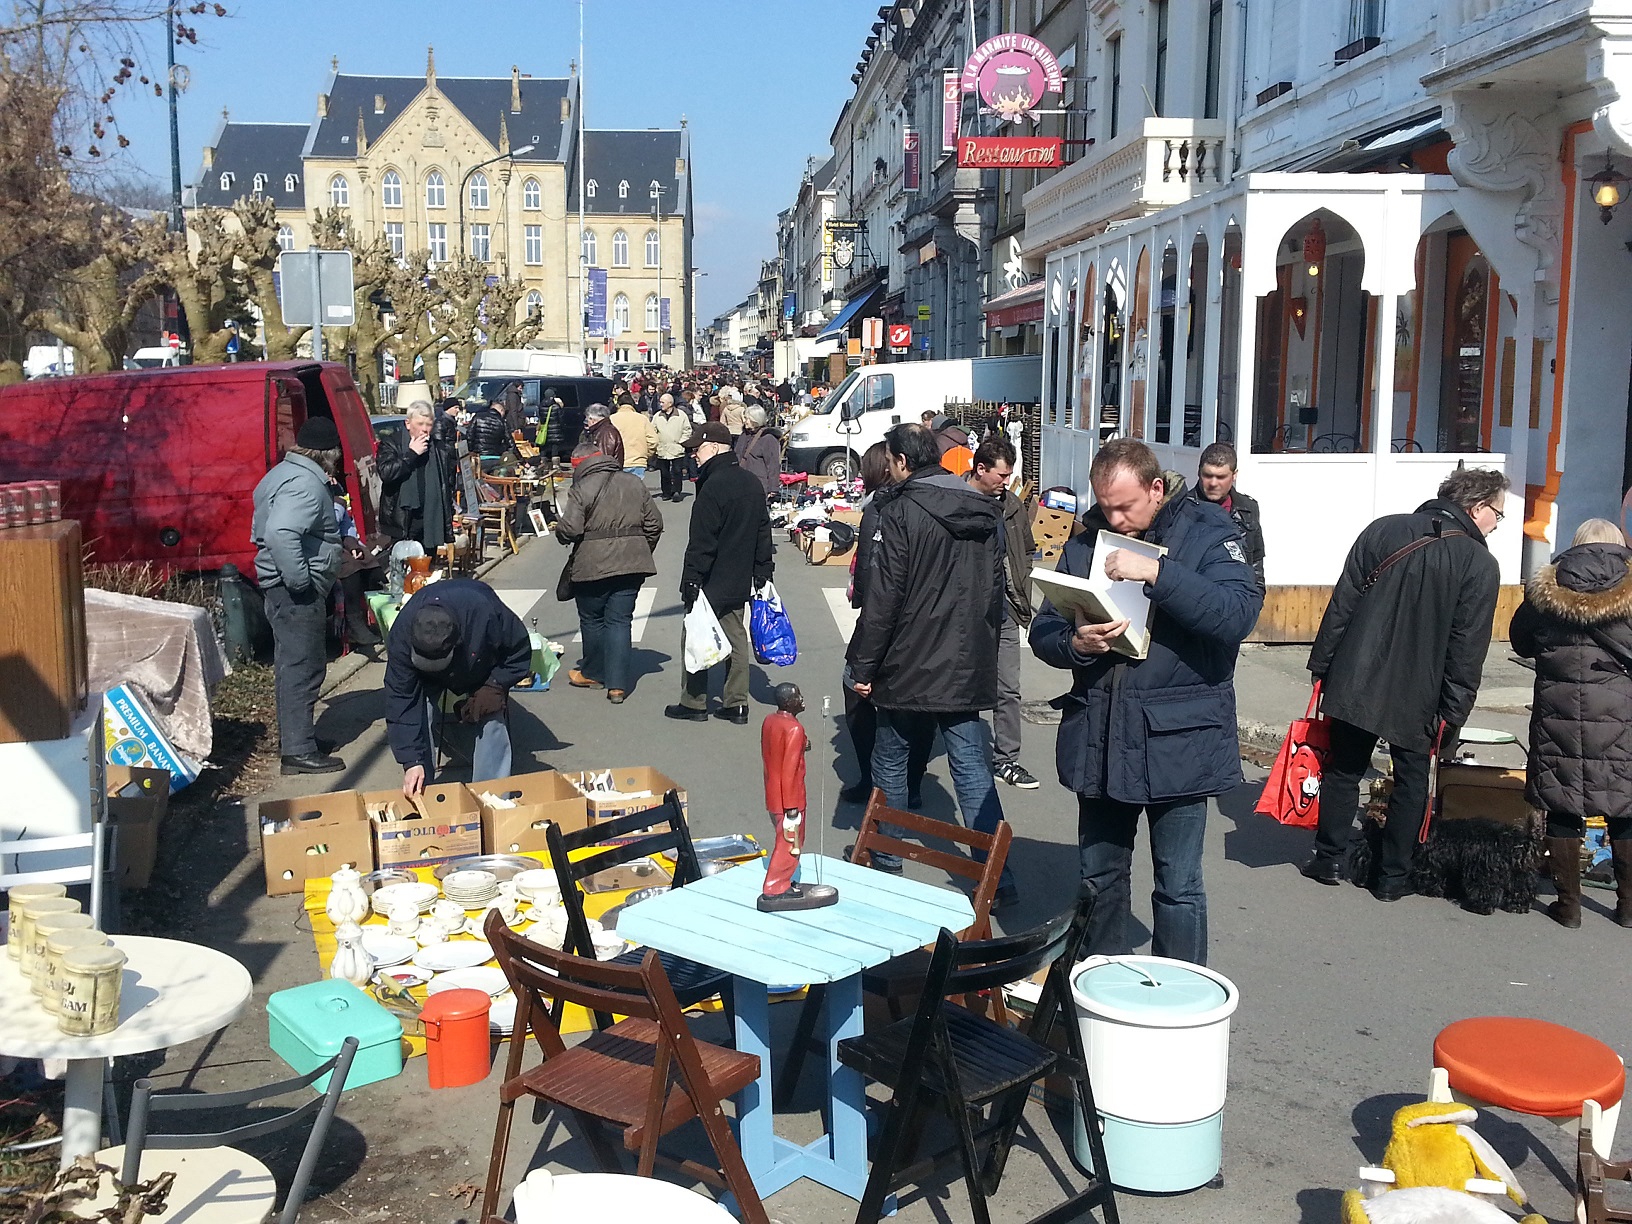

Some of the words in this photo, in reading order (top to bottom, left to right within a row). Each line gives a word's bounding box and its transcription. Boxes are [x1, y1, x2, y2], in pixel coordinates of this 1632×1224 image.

[975, 35, 1017, 63] MARMITE
[965, 63, 978, 78] LA
[1021, 38, 1061, 92] UKRAINIENNE
[963, 82, 974, 90] A
[962, 140, 1056, 166] Restaurant
[116, 698, 149, 739] PREMIUM
[147, 741, 180, 782] BANANAS
[413, 826, 436, 837] UTC
